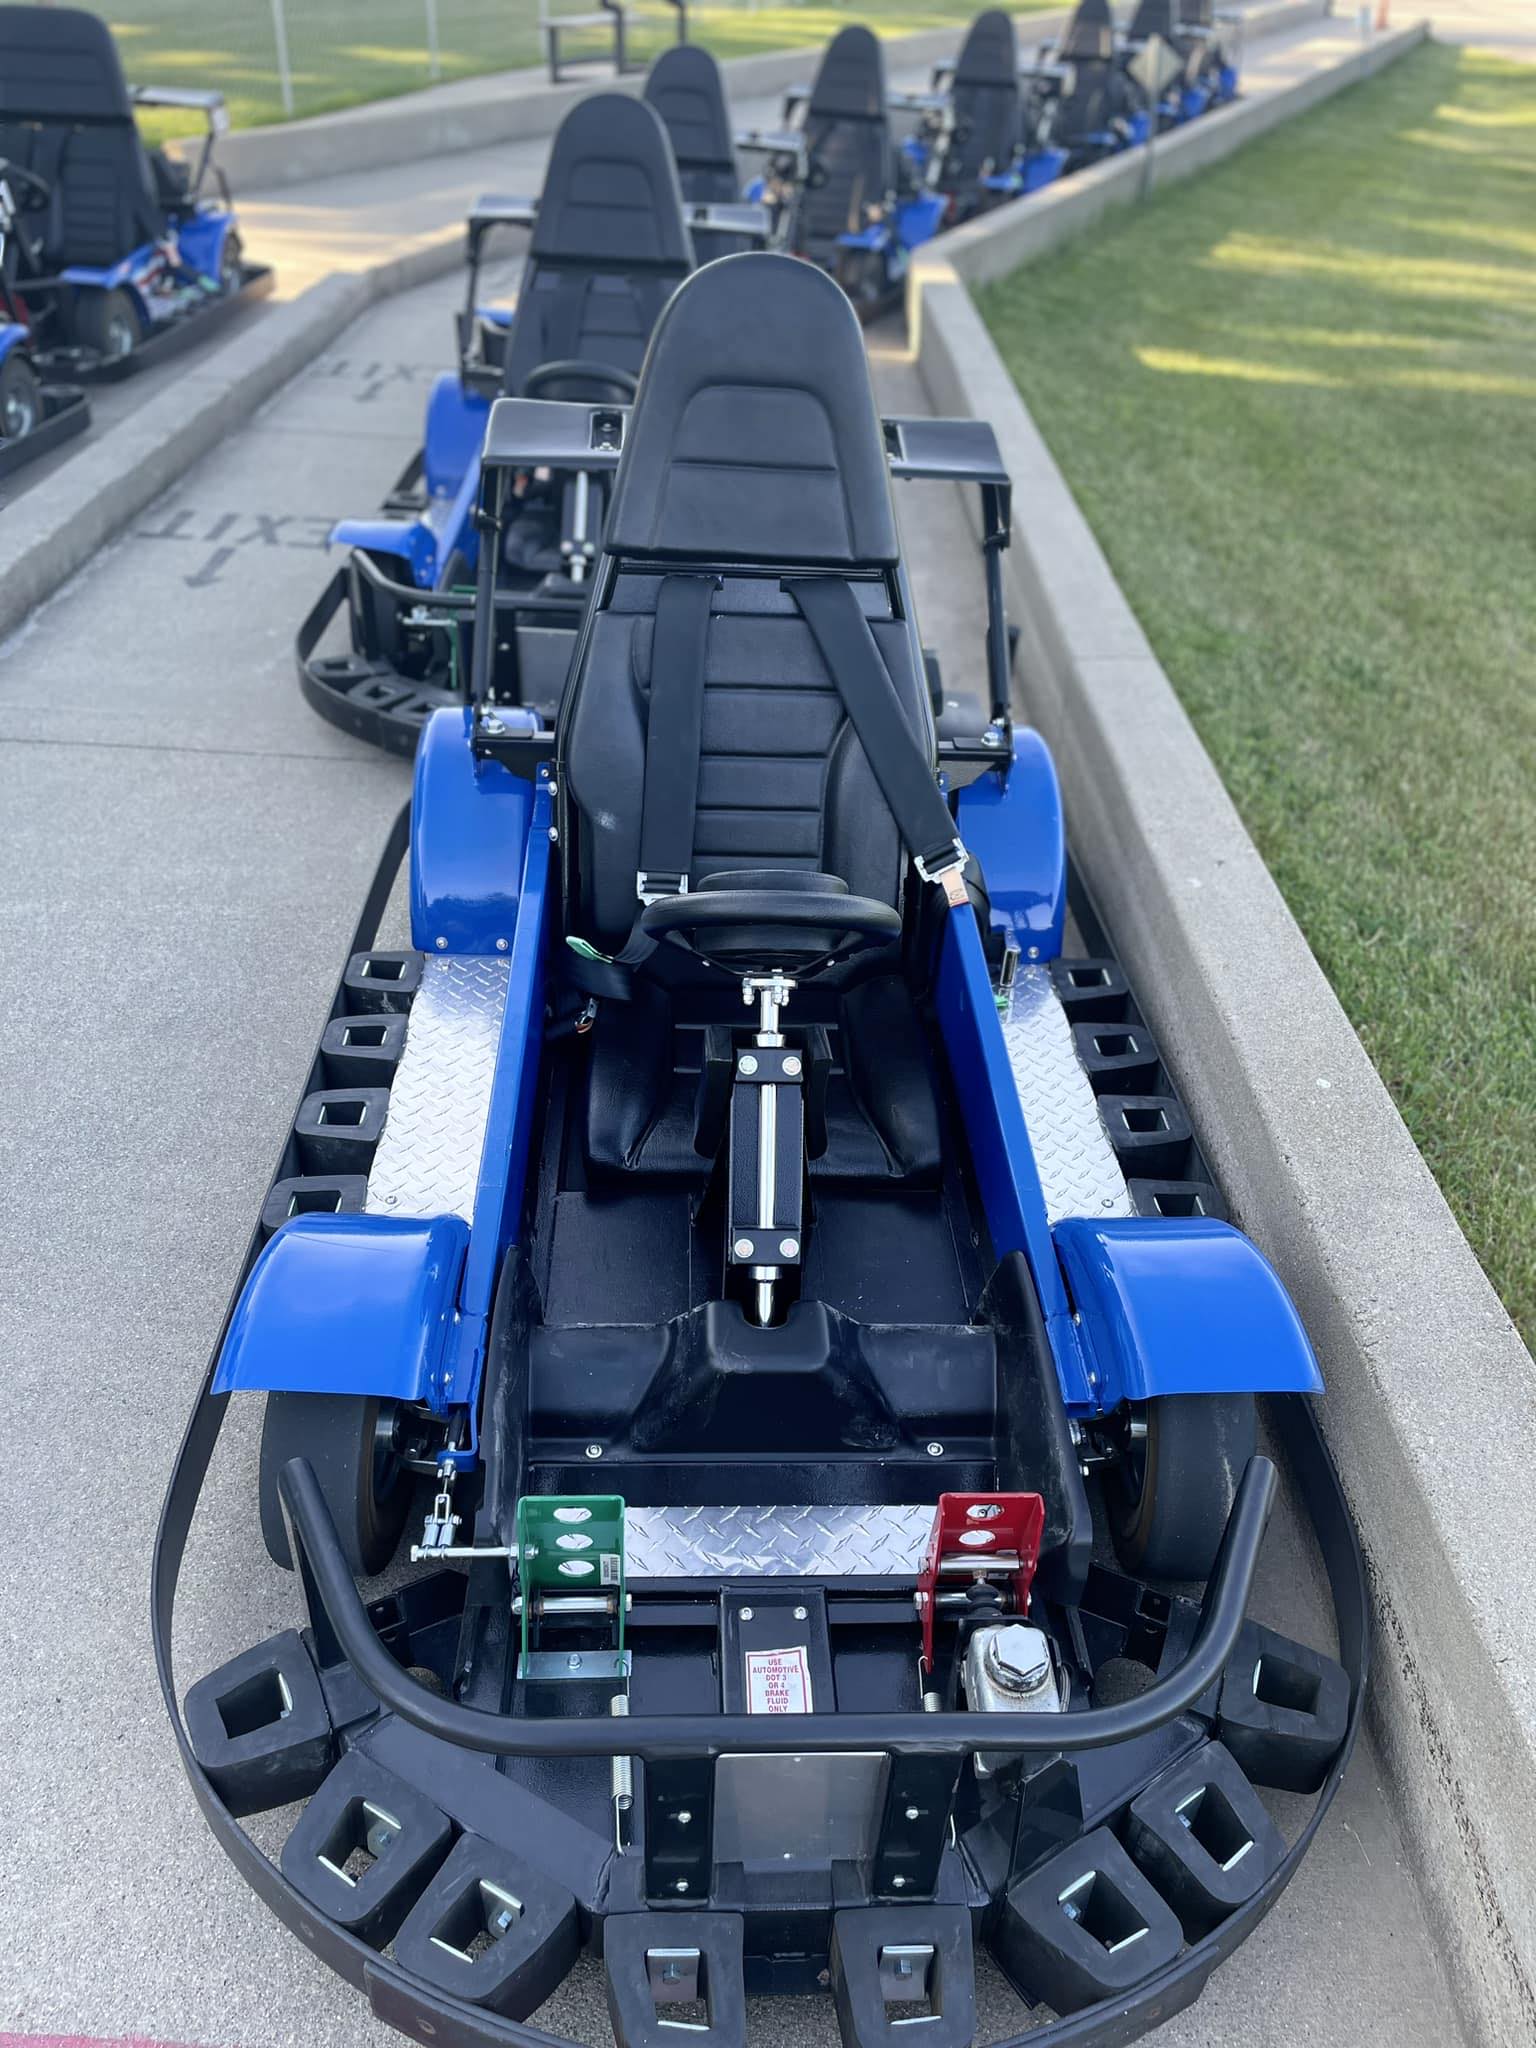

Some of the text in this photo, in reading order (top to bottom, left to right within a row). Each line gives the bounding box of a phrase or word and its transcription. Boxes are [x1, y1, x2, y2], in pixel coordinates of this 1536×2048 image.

[768, 1658, 782, 1666] USE
[752, 1665, 799, 1674] AUTOMOTIVE
[765, 1689, 789, 1697] BRAKE
[767, 1697, 788, 1705] FLUID
[768, 1705, 788, 1713] ONLY
